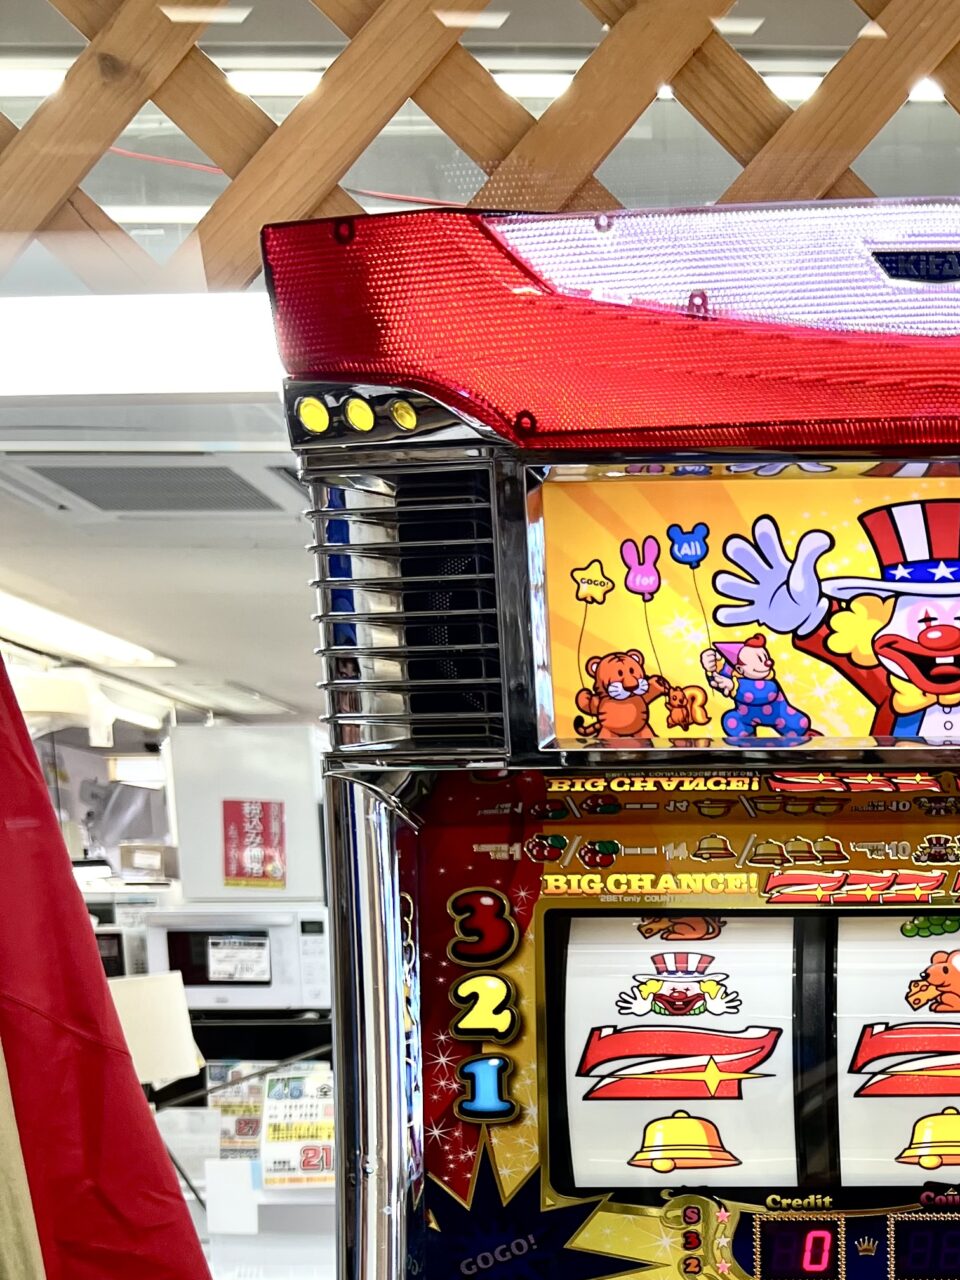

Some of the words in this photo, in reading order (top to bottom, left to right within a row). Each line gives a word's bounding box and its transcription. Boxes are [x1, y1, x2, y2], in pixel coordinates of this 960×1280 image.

[680, 541, 701, 556] All
[580, 577, 609, 588] GOGO!
[636, 574, 655, 587] for
[543, 873, 604, 895] BIG
[605, 873, 760, 895] CHANCE!
[449, 889, 518, 964] 3
[450, 971, 519, 1043] 2
[455, 1056, 519, 1122] 1
[765, 1194, 834, 1210] Credit
[459, 1233, 538, 1277] GOGO!
[802, 1230, 832, 1272] 0
[683, 1256, 701, 1274] 2
